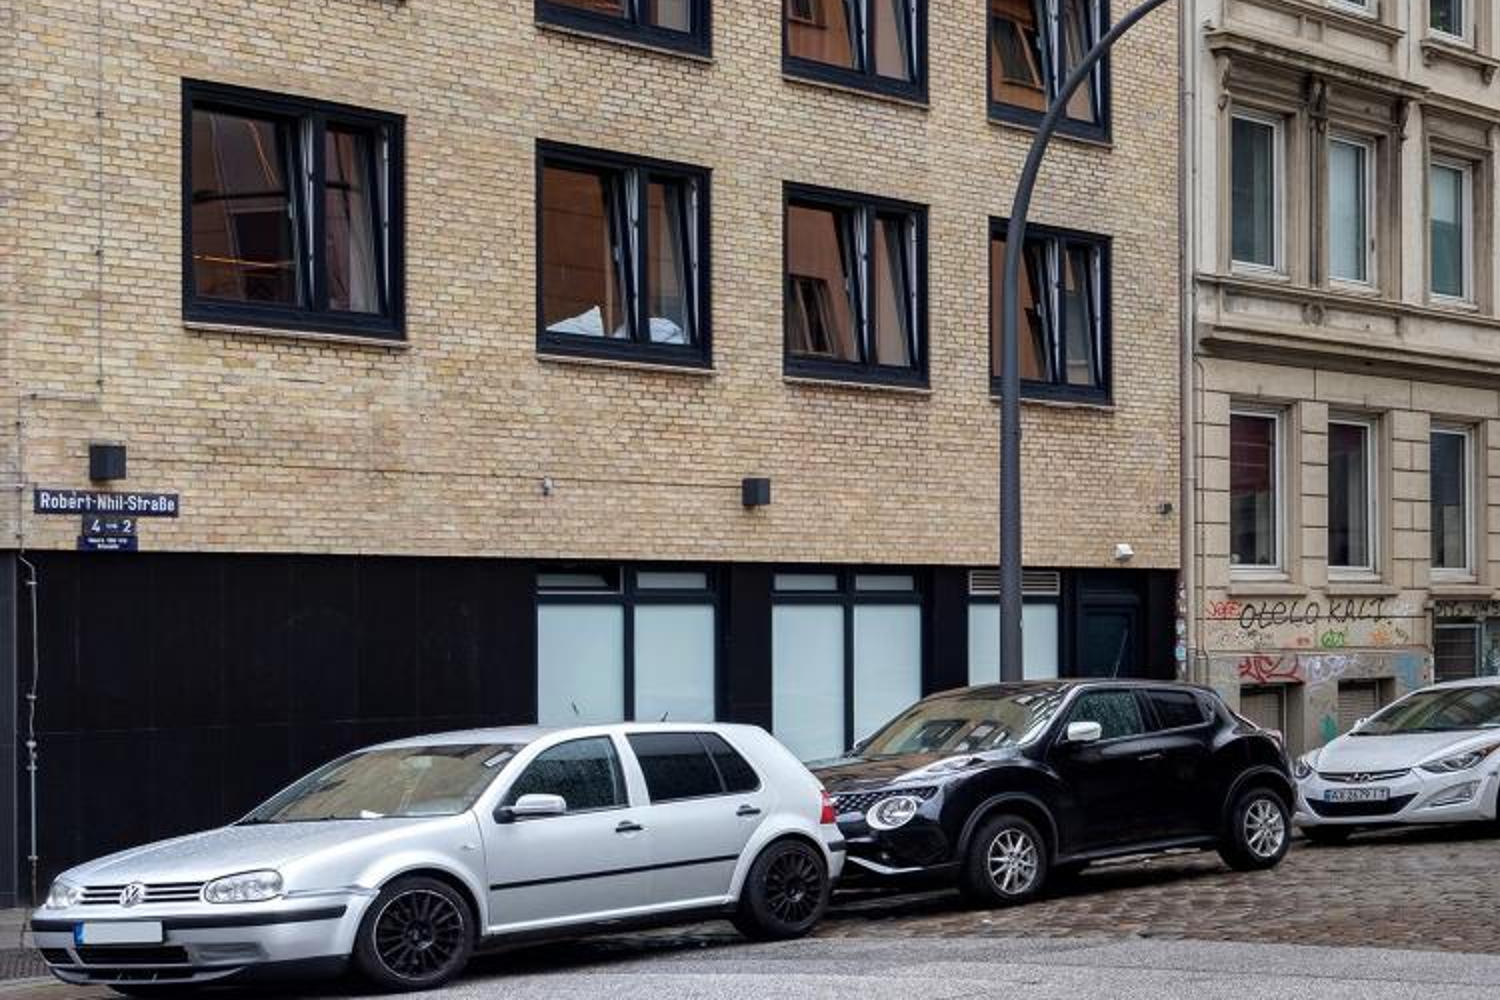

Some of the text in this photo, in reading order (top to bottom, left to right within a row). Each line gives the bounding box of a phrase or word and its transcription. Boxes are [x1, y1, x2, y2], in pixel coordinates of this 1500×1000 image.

[39, 491, 176, 512] Robert-Nhil-Straße
[91, 519, 132, 533] 4 2
